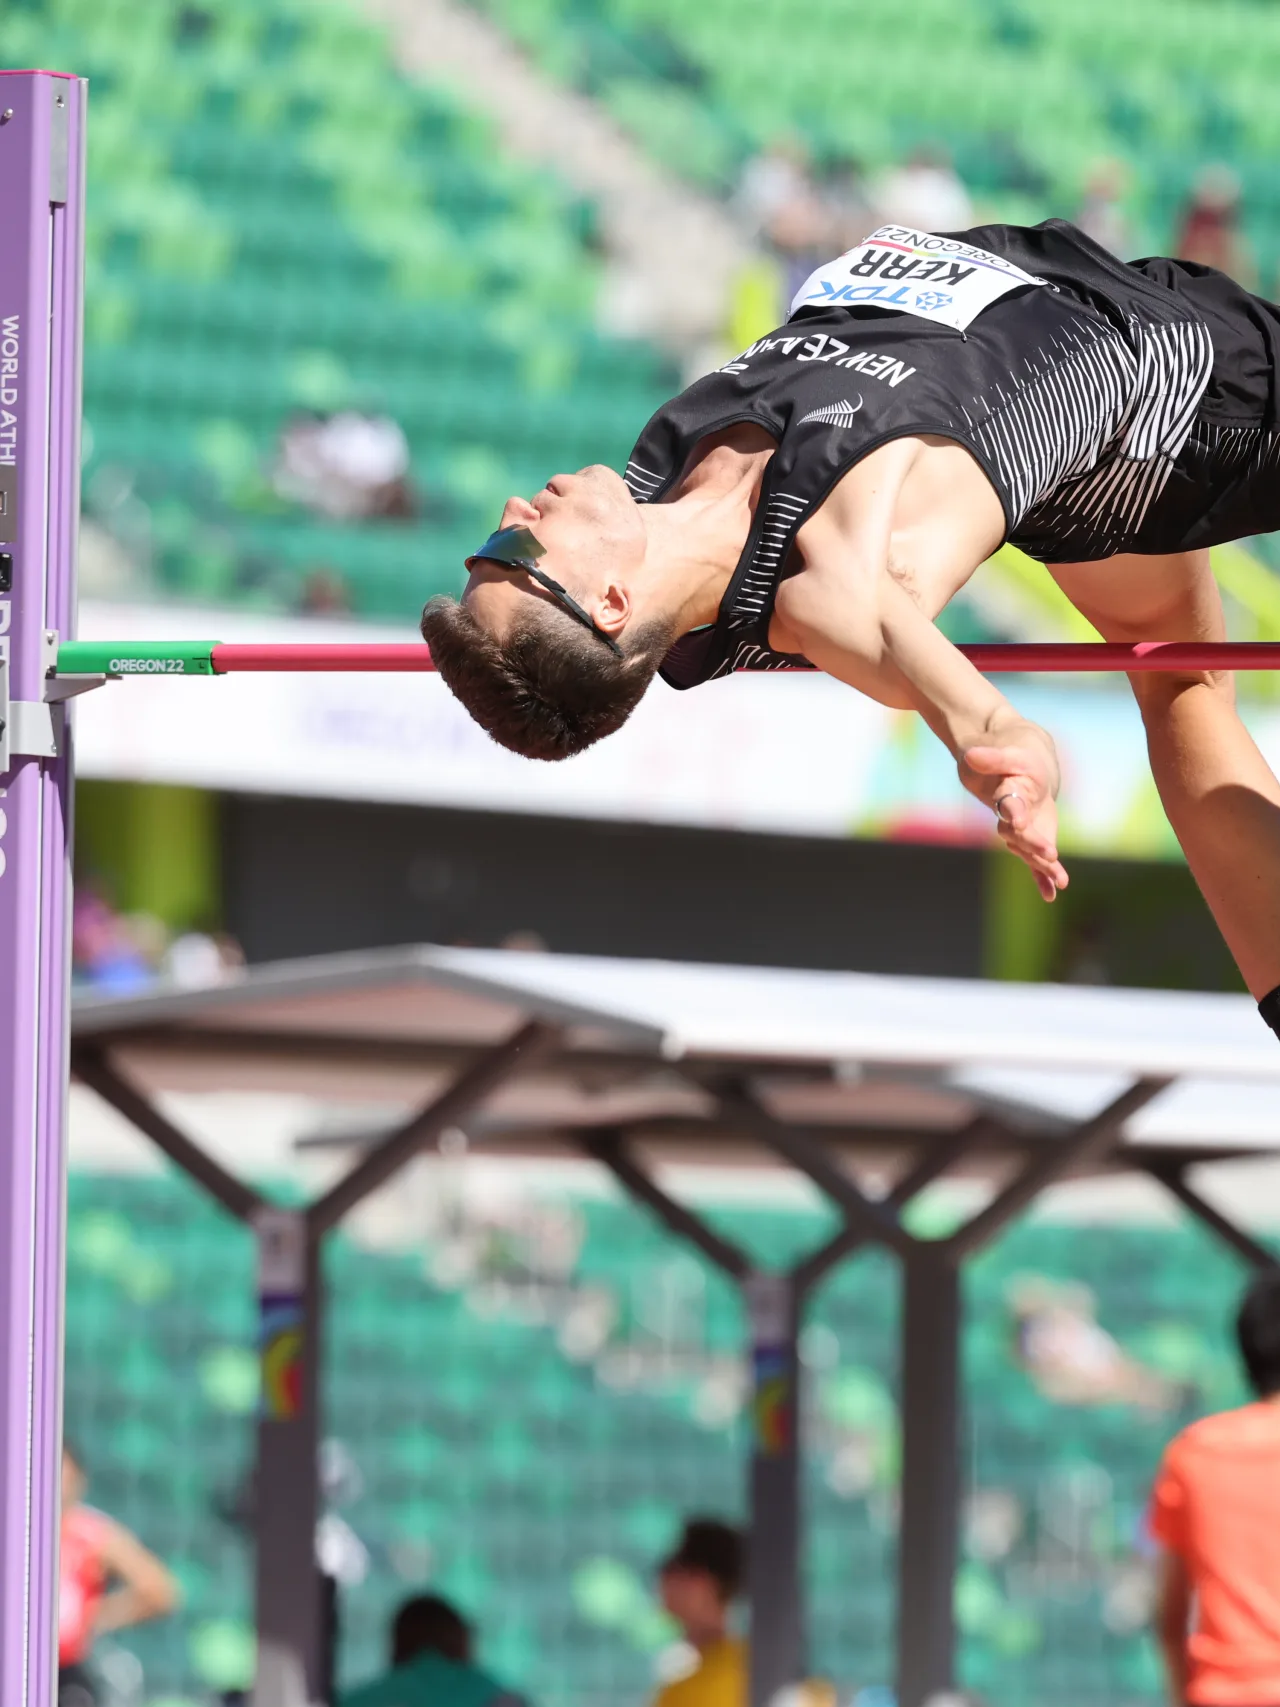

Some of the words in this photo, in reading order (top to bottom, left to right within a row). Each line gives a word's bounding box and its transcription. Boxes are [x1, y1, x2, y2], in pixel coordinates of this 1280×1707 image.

[873, 227, 1011, 268] OREGON22
[849, 248, 978, 286] KERR
[805, 280, 912, 305] TDK
[0, 314, 20, 405] WORLD
[835, 351, 917, 389] NEW
[109, 658, 185, 672] OREGON22
